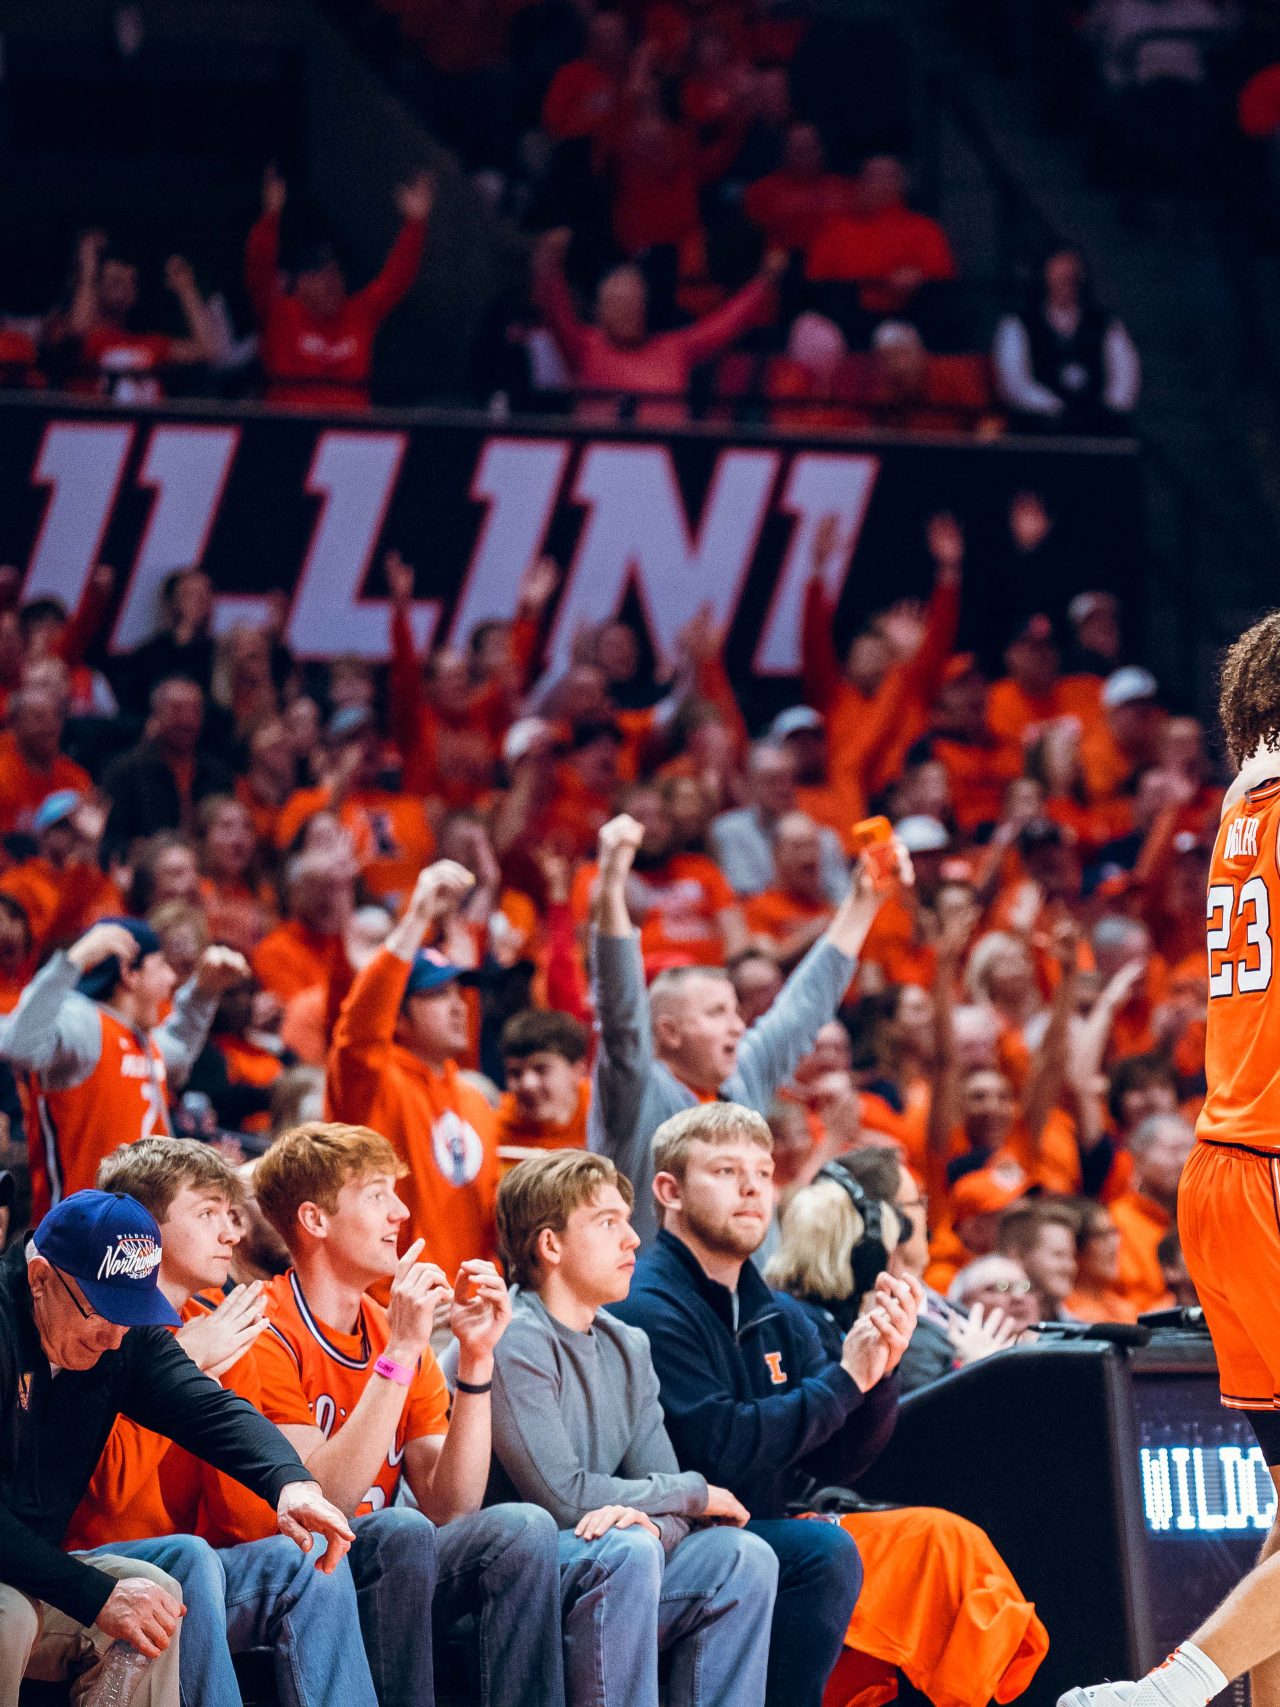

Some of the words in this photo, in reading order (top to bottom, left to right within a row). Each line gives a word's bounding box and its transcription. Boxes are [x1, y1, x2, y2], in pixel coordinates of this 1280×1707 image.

[18, 421, 879, 692] ILLINI
[1206, 875, 1273, 1000] 23
[1140, 1446, 1279, 1530] WILDC
